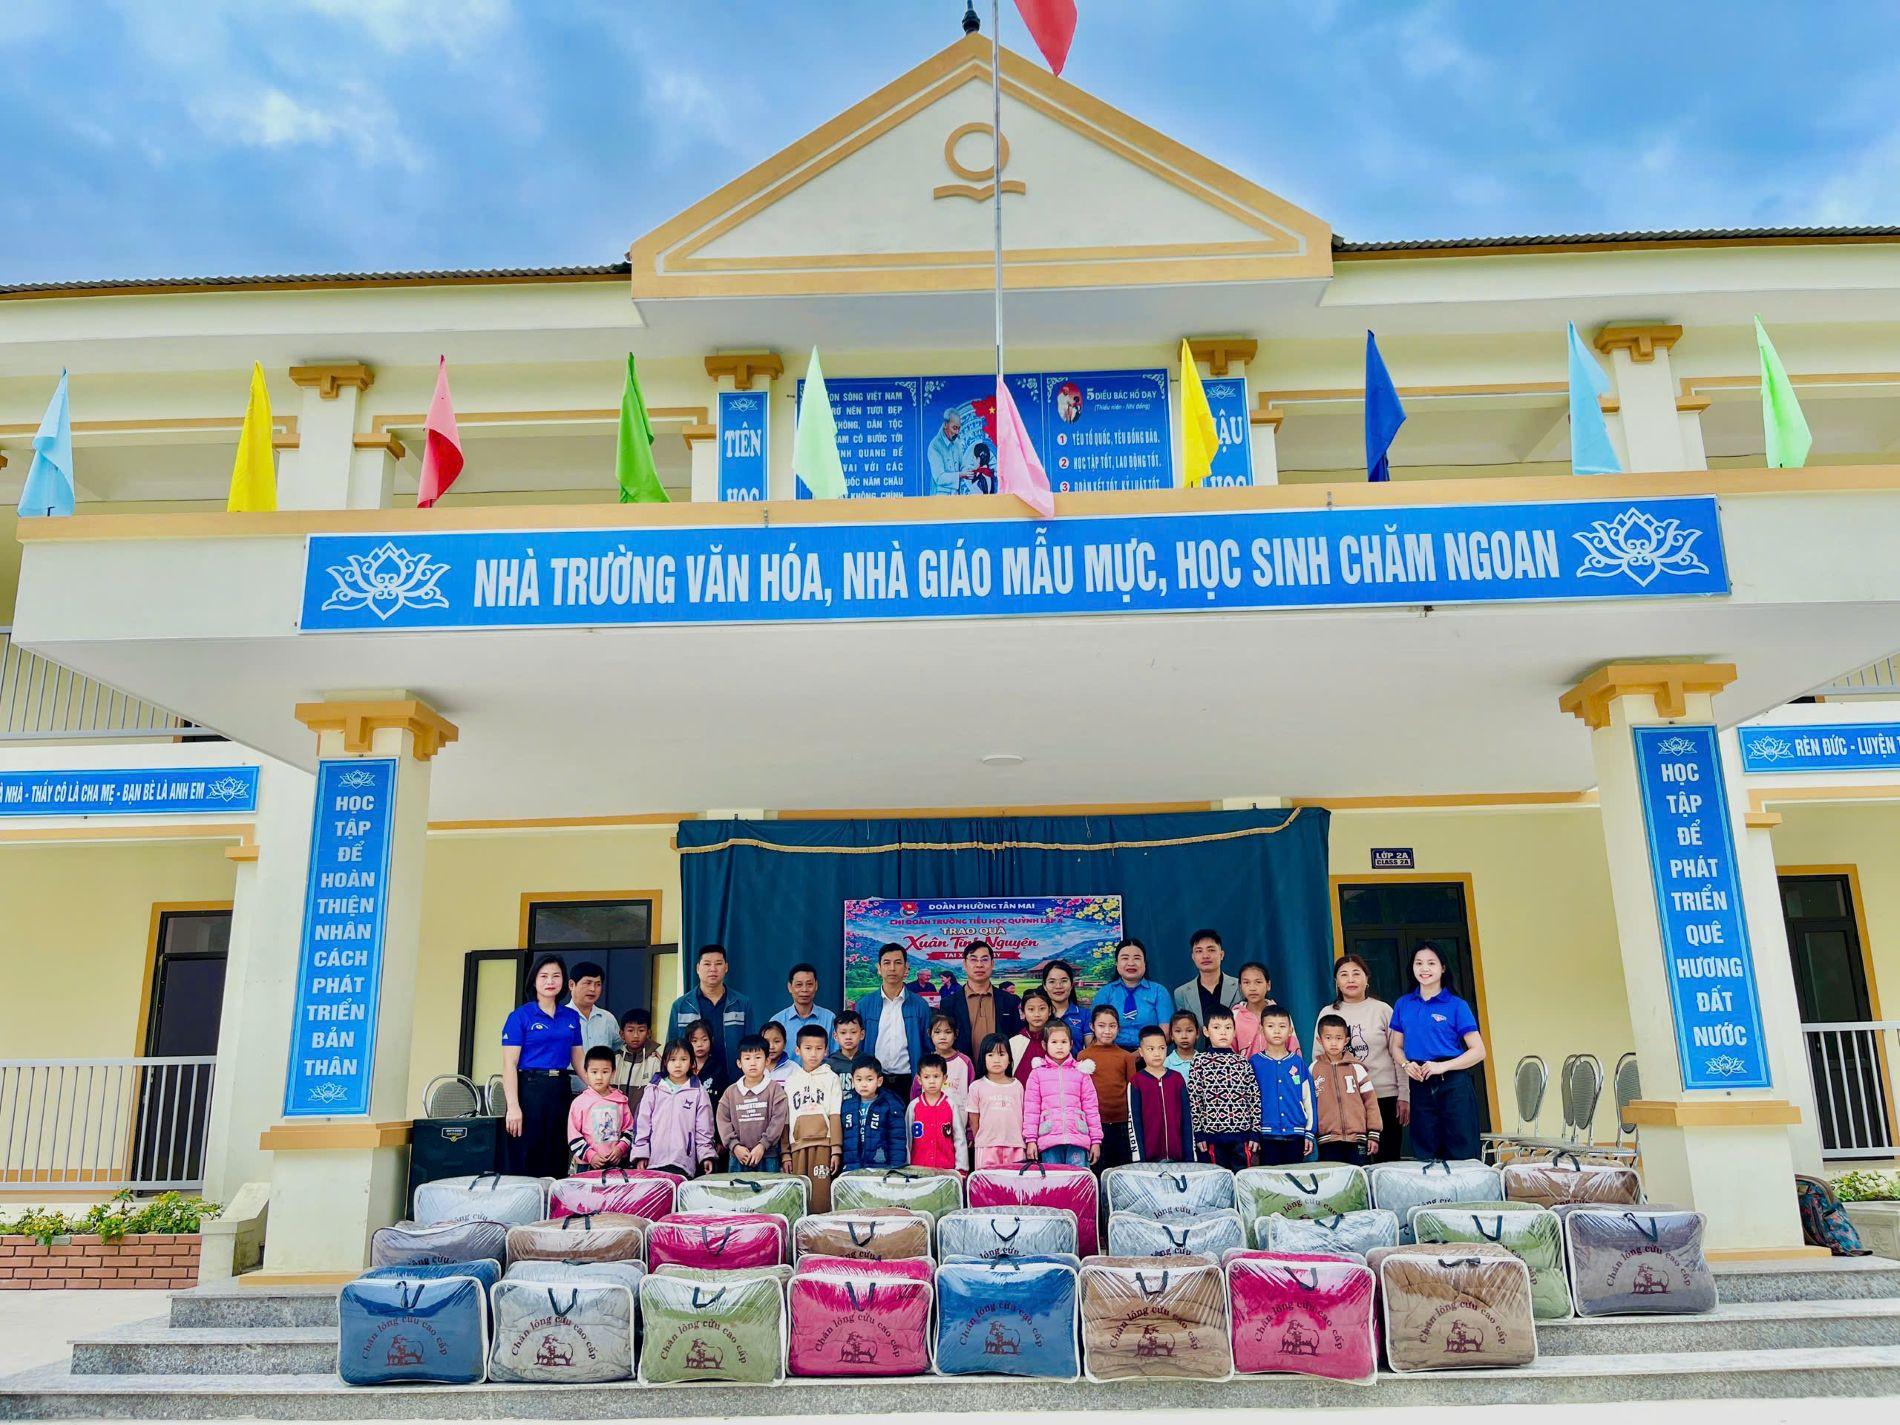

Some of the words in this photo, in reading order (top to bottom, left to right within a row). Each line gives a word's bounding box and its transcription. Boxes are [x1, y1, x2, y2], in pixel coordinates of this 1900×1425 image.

[843, 391, 863, 401] SÔNG
[866, 391, 881, 402] VIỆT
[885, 392, 903, 400] NAM
[1086, 387, 1095, 400] 5
[1114, 389, 1128, 399] BÁC
[1129, 388, 1140, 399] HỒ
[846, 406, 862, 415] NÊN
[867, 405, 883, 415] TƯƠI
[888, 405, 903, 416] ĐẸP
[867, 418, 882, 429] DÂN
[888, 418, 903, 430] TỘC
[1213, 408, 1244, 454] ẬU
[724, 421, 762, 458] TIÊN
[853, 433, 863, 443] CÓ
[867, 433, 887, 443] BƯỚC
[891, 433, 903, 442] TỚI
[1072, 430, 1084, 446] YÊU
[1114, 429, 1125, 445] YÊU
[858, 448, 886, 458] QUANG
[893, 445, 903, 457] ĐỂ
[864, 461, 879, 471] VỚI
[886, 462, 903, 471] CÁC
[1073, 456, 1086, 472] HỌC
[1087, 453, 1099, 472] TẬP
[1116, 455, 1128, 468] LAO
[1129, 452, 1146, 471] ĐỘNG
[863, 476, 880, 486] NĂM
[883, 476, 903, 486] CHÂU
[473, 548, 540, 607] NHÀ
[551, 544, 676, 606] TRƯỜNG
[686, 543, 750, 604] VĂN
[760, 542, 833, 607] HÓA,
[843, 540, 909, 600] NHÀ
[918, 538, 992, 598] GIÁO
[1002, 527, 1074, 596] MẪU
[1084, 537, 1168, 603] MỰC,
[1176, 538, 1242, 600] HỌC
[1251, 535, 1331, 588] SINH
[1339, 523, 1437, 585] CHĂM
[1443, 529, 1560, 583] NGOAN
[1795, 735, 1821, 757] RÈN
[1822, 734, 1848, 756] ĐỨC
[1857, 733, 1895, 758] LUYỆN
[1661, 763, 1699, 786] HỌC
[5, 781, 24, 803] NHÀ
[54, 781, 67, 803] CÔ
[68, 780, 79, 802] LÀ
[81, 784, 99, 802] CHA
[101, 784, 115, 805] MẸ
[122, 783, 141, 805] BẠN
[142, 780, 155, 801] BÈ
[156, 779, 168, 801] LÀ
[170, 782, 189, 800] ANH
[190, 782, 205, 800] EM
[335, 795, 375, 814] HỌC
[1666, 791, 1702, 817] TẬP
[335, 818, 371, 839] TẬP
[1677, 819, 1703, 846] ĐỂ
[337, 840, 365, 862] ĐỂ
[1375, 851, 1393, 859] LỚP
[1670, 855, 1718, 878] PHÁT
[321, 869, 375, 888] HOÀN
[317, 895, 375, 916] THIỆN
[928, 901, 956, 910] ĐOÀN
[957, 901, 997, 910] PHƯỜNG
[998, 901, 1016, 910] TÂN
[1671, 884, 1728, 911] TRIỂN
[315, 921, 372, 941] NHÂN
[941, 927, 977, 936] TRAO
[979, 926, 1007, 936] QUÀ
[989, 918, 1007, 926] HỌC
[903, 933, 949, 951] Xuân
[985, 935, 1040, 951] Nguyện
[1685, 920, 1724, 946] QUÊ
[314, 947, 368, 967] CÁCH
[1676, 956, 1744, 979] HƯƠNG
[312, 975, 365, 994] PHÁT
[1696, 985, 1733, 1012] ĐẤT
[307, 998, 365, 1021] TRIỂN
[312, 1026, 355, 1049] BẢN
[1693, 1022, 1747, 1047] NƯỚC
[304, 1056, 357, 1076] THÂN
[1665, 1252, 1680, 1267] cao
[1172, 1314, 1188, 1329] cao
[1481, 1308, 1496, 1324] cao
[573, 1324, 587, 1340] cao
[722, 1327, 737, 1343] cao
[877, 1322, 891, 1338] cao
